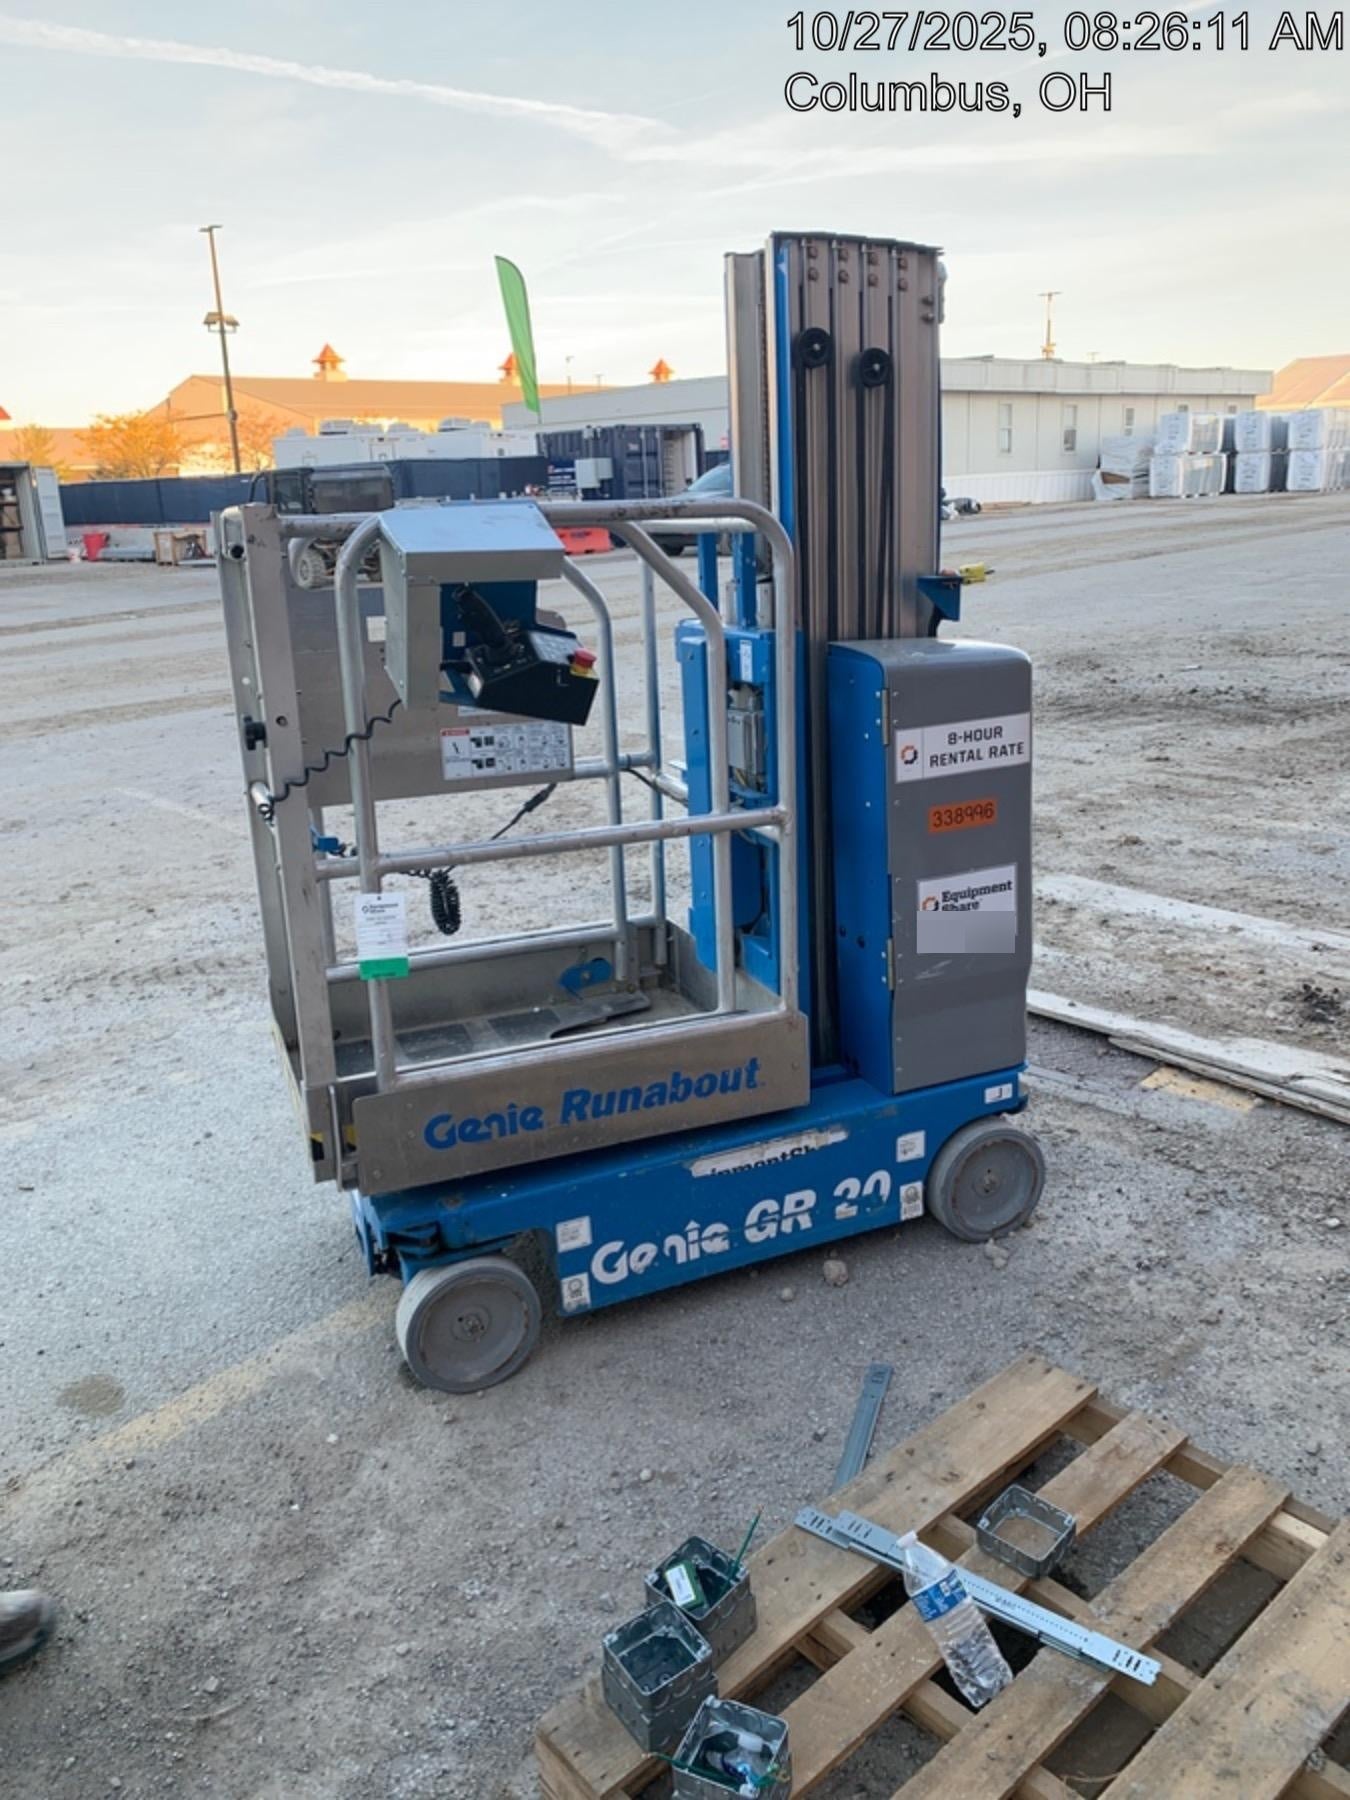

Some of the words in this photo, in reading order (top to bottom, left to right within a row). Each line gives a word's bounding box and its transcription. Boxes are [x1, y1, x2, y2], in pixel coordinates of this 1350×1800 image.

[947, 725, 1003, 745] 8-HOUR
[929, 749, 983, 768] RENTAL
[988, 741, 1025, 759] RATE
[932, 802, 995, 828] 338996
[941, 880, 1013, 903] Equipment
[423, 1102, 545, 1151] Genie
[560, 1056, 761, 1127] Runabout
[590, 1220, 730, 1285] Genie
[743, 1188, 817, 1243] GR
